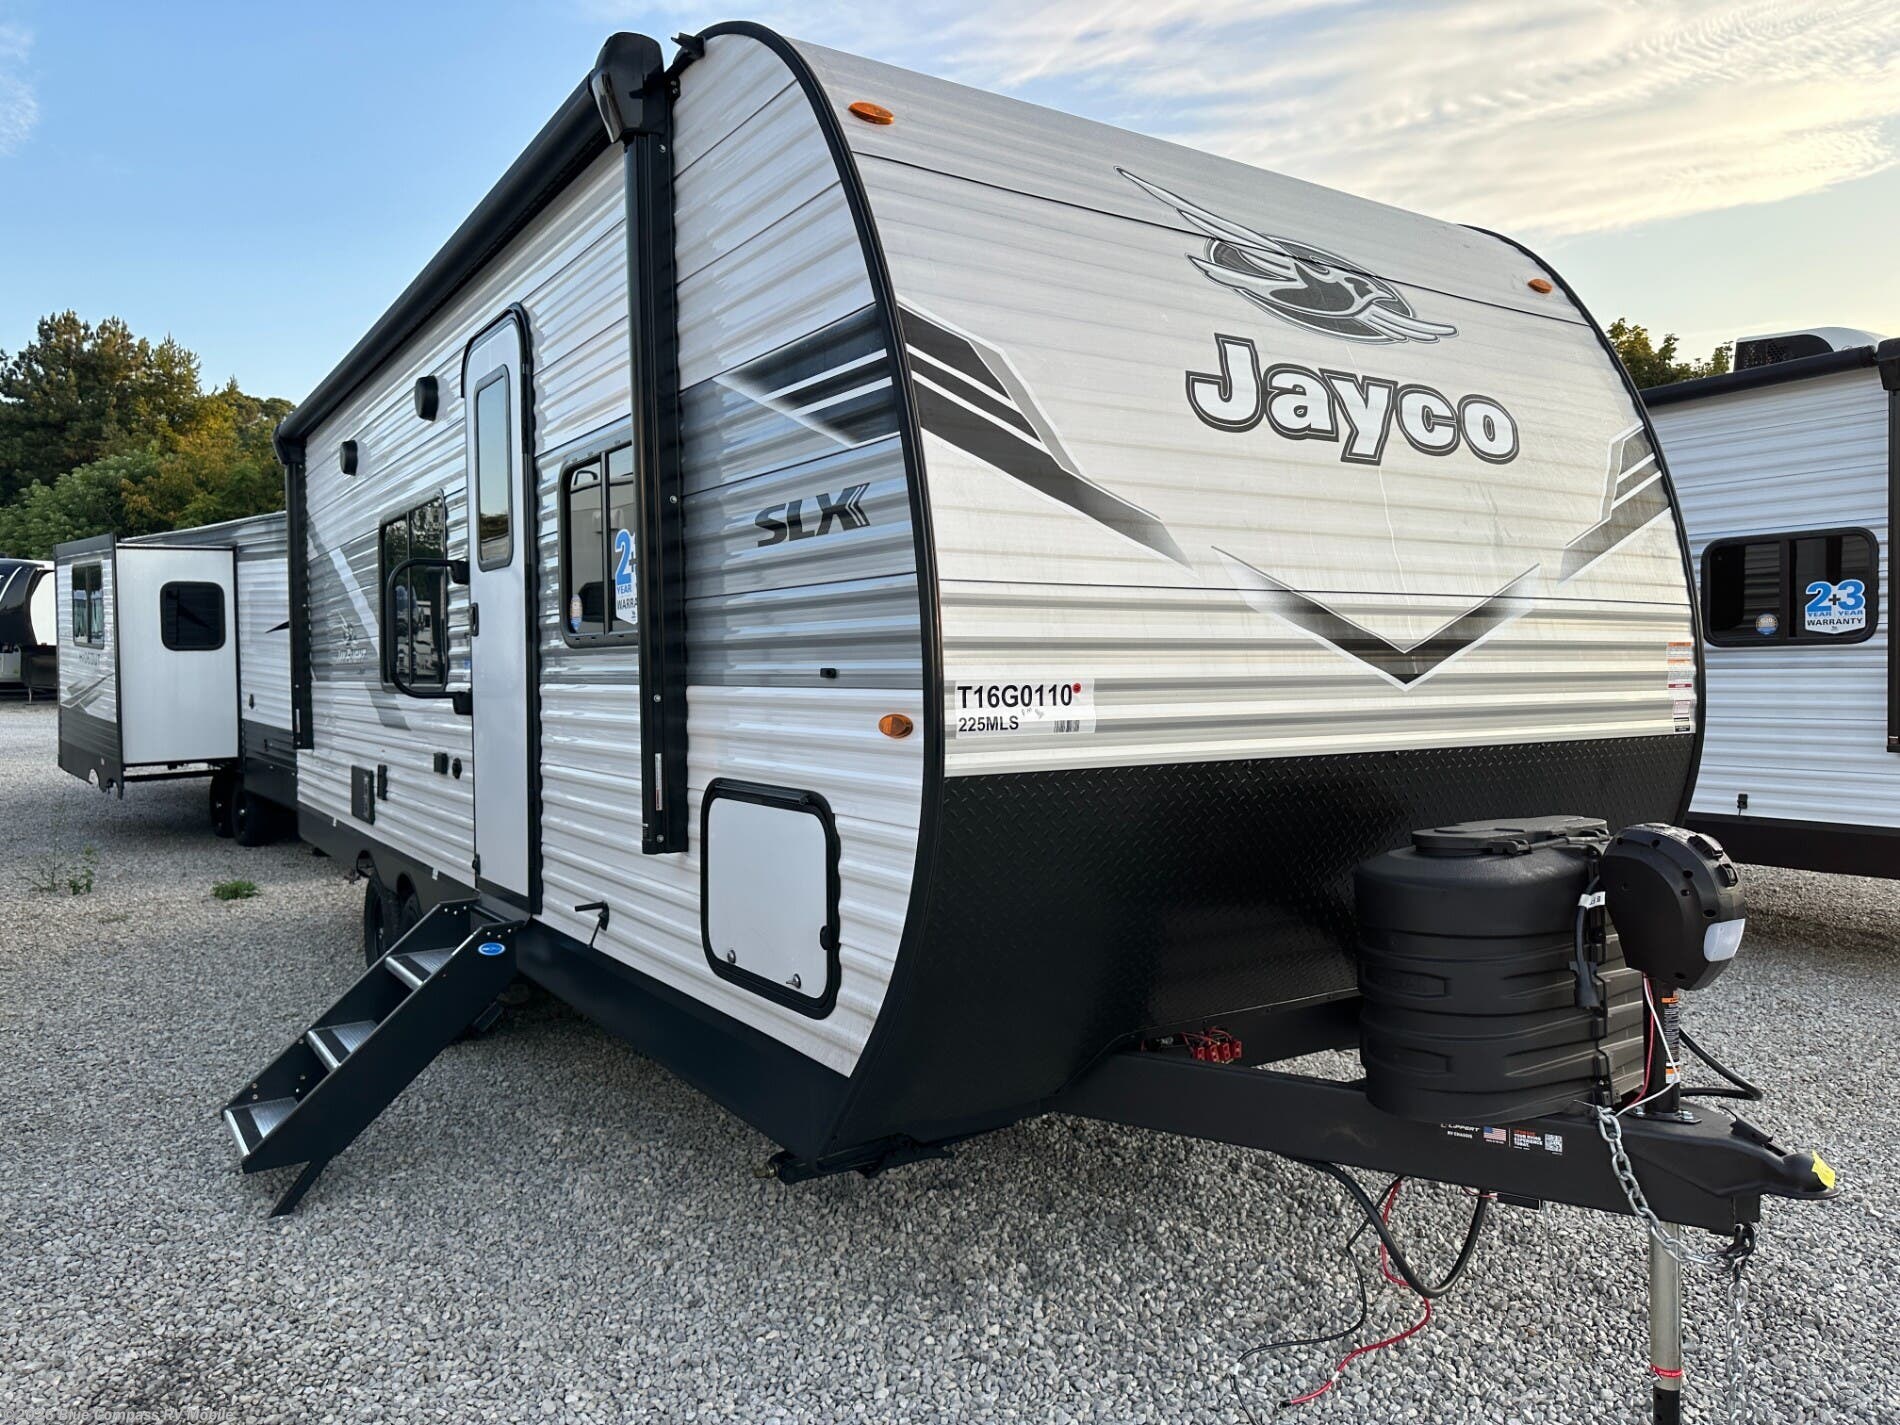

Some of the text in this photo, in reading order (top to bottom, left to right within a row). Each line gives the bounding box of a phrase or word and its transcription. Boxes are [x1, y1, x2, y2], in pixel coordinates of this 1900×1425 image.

[1185, 332, 1520, 466] Jayco
[754, 482, 871, 547] SLX
[616, 585, 632, 595] YEAR
[617, 598, 637, 609] WARRA
[1807, 617, 1863, 626] WARRANTY
[957, 684, 1072, 708] T16G0110
[958, 715, 1019, 732] 225MLS
